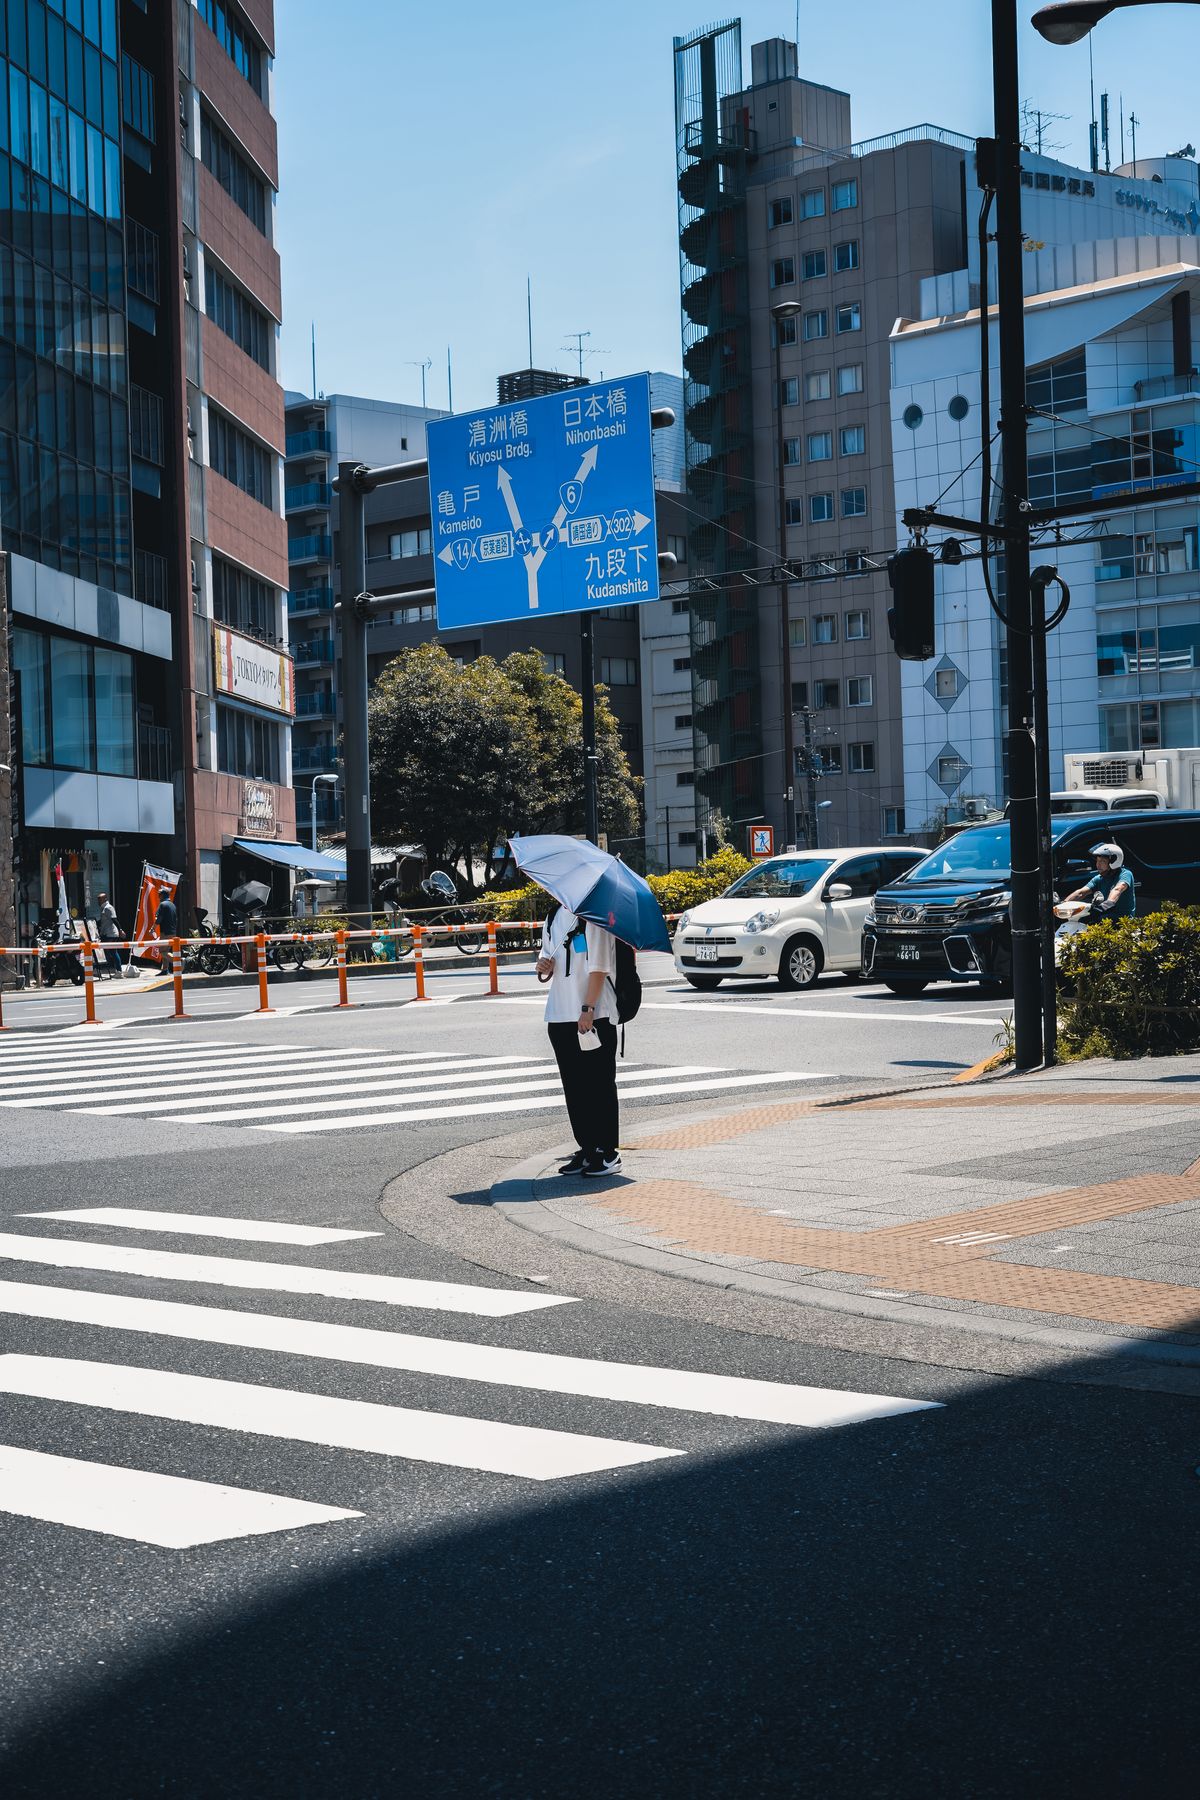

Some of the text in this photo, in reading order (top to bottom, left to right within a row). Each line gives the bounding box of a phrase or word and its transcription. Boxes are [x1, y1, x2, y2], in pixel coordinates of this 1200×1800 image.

[563, 387, 627, 427] 日本橋
[468, 409, 528, 448] 清洲橋
[566, 419, 627, 446] Nihonbashi
[469, 441, 533, 467] Kiyosu Brdg.
[437, 484, 480, 516] 亀戸
[566, 485, 576, 504] 6
[439, 515, 482, 535] Kameido
[613, 516, 632, 533] 302
[457, 542, 470, 561] 14
[585, 544, 649, 581] 九段下
[587, 578, 649, 600] Kudanshita
[900, 950, 920, 960] 66-10
